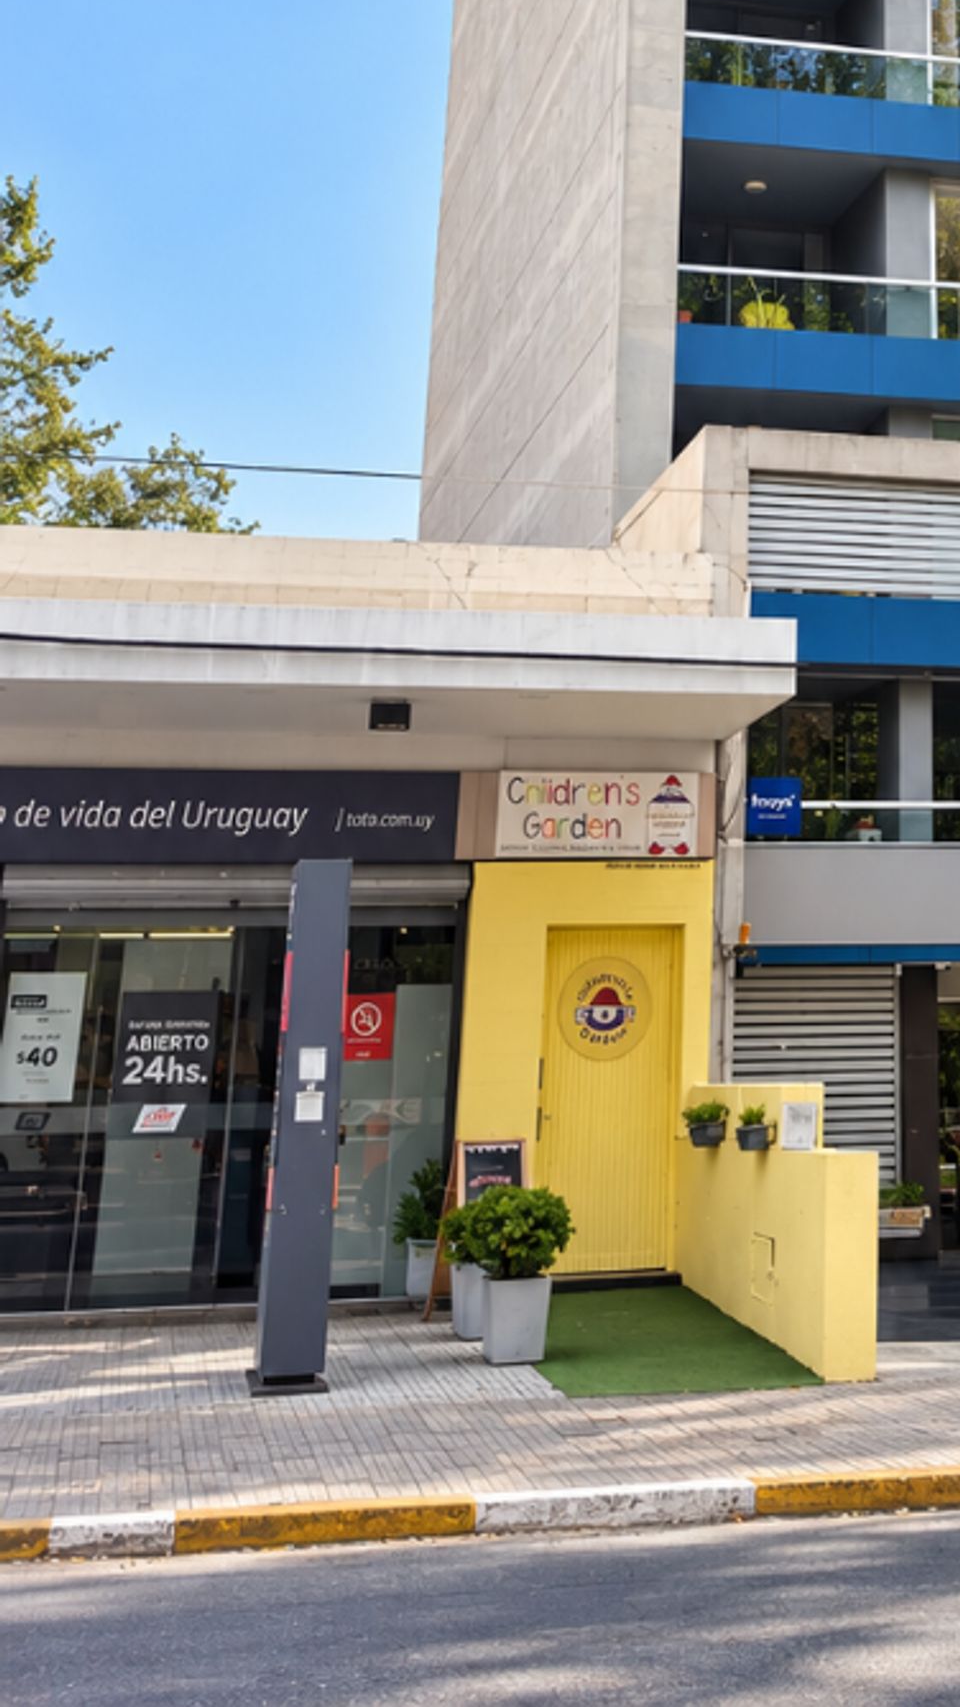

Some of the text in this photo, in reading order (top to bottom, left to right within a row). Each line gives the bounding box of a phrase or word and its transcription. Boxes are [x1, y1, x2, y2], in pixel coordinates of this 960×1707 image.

[14, 798, 51, 828] de
[60, 799, 122, 828] vida
[129, 800, 176, 828] del
[181, 801, 309, 837] Uruguay
[523, 811, 622, 839] Garden
[125, 1034, 209, 1051] ABIERTO
[121, 1055, 208, 1084] 24hs.
